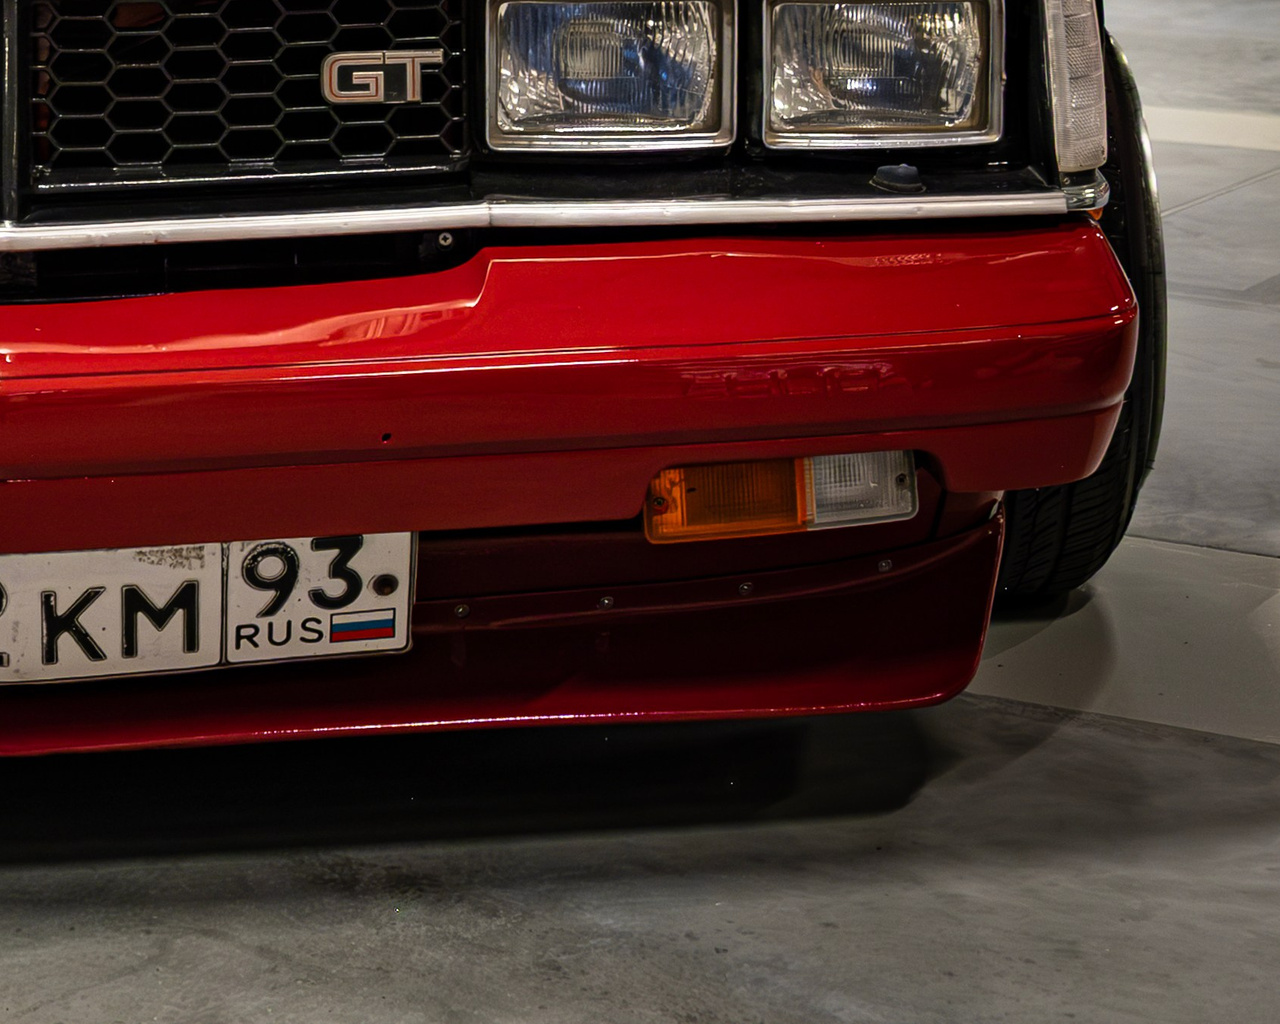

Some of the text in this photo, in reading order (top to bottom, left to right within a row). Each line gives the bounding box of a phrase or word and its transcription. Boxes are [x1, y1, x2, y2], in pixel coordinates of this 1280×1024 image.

[322, 48, 445, 104] GT
[241, 533, 365, 619] 93
[234, 616, 325, 651] RUS
